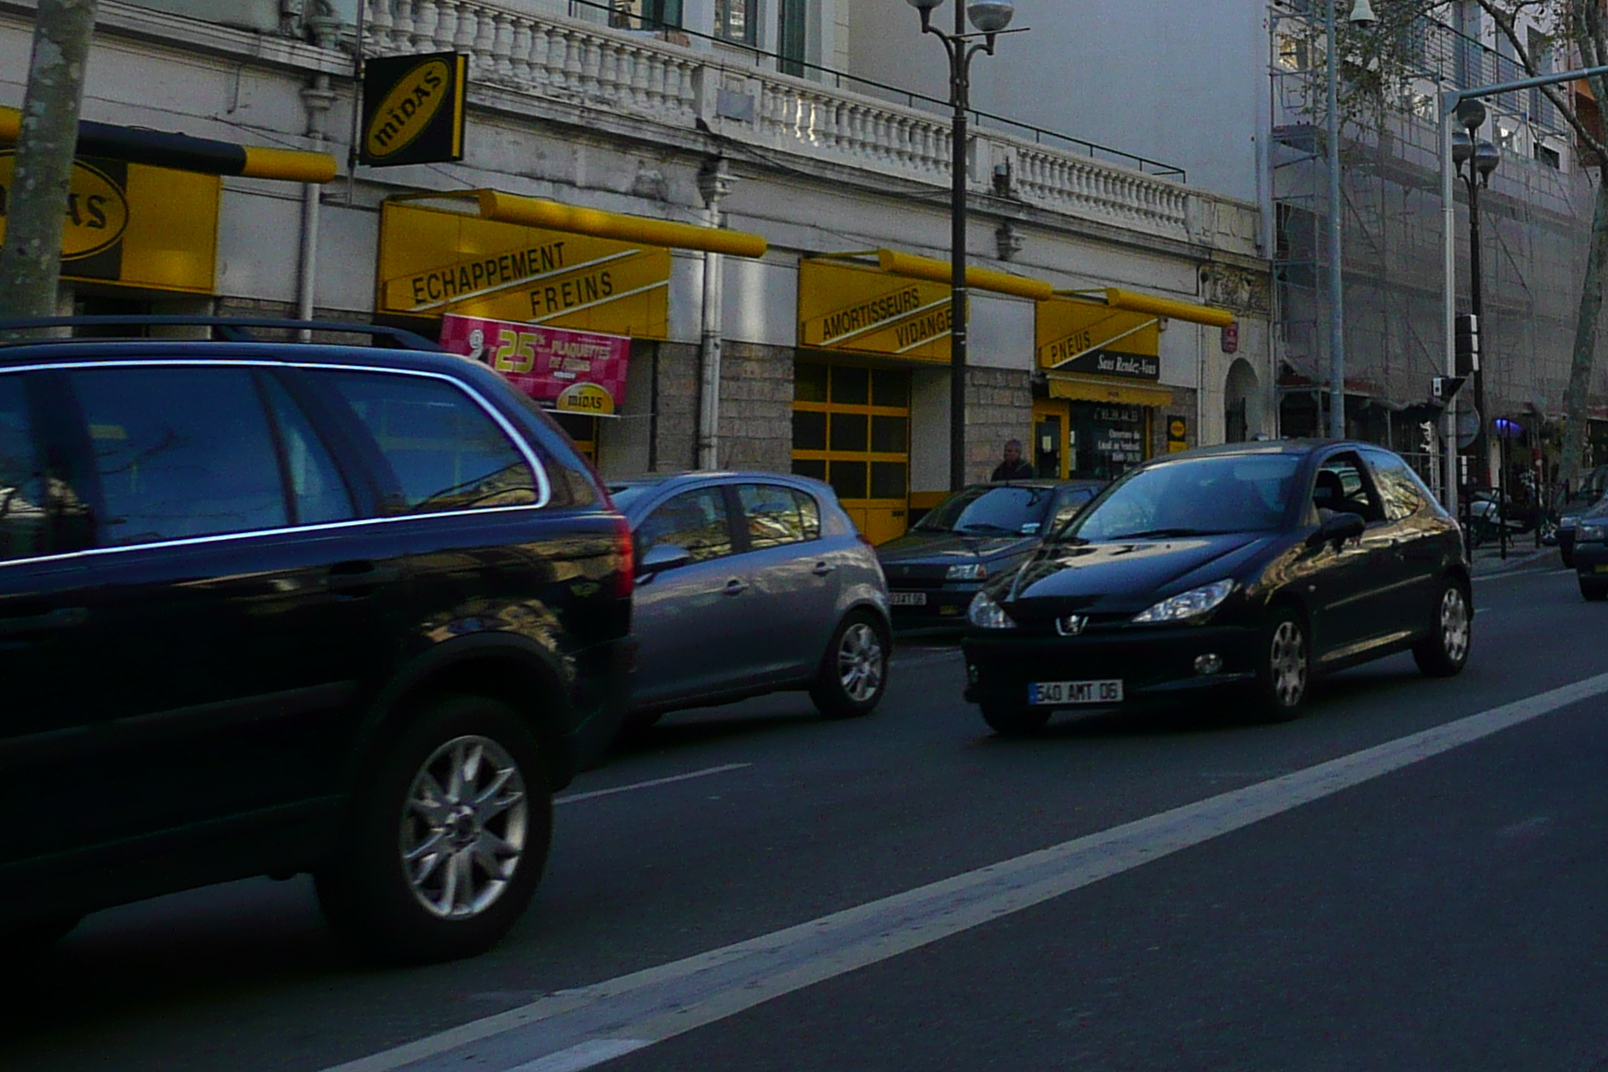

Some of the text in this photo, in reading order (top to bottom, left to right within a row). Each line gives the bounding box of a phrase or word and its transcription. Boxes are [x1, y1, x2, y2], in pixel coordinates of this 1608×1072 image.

[411, 241, 566, 305] ECHAPPEMENT
[530, 272, 614, 317] FREINS
[822, 288, 920, 340] AMORTISSEURS
[552, 340, 612, 361] PLAQUETTES
[1051, 331, 1092, 364] PNEUS
[1097, 354, 1156, 375] Sans Rendez-Vous
